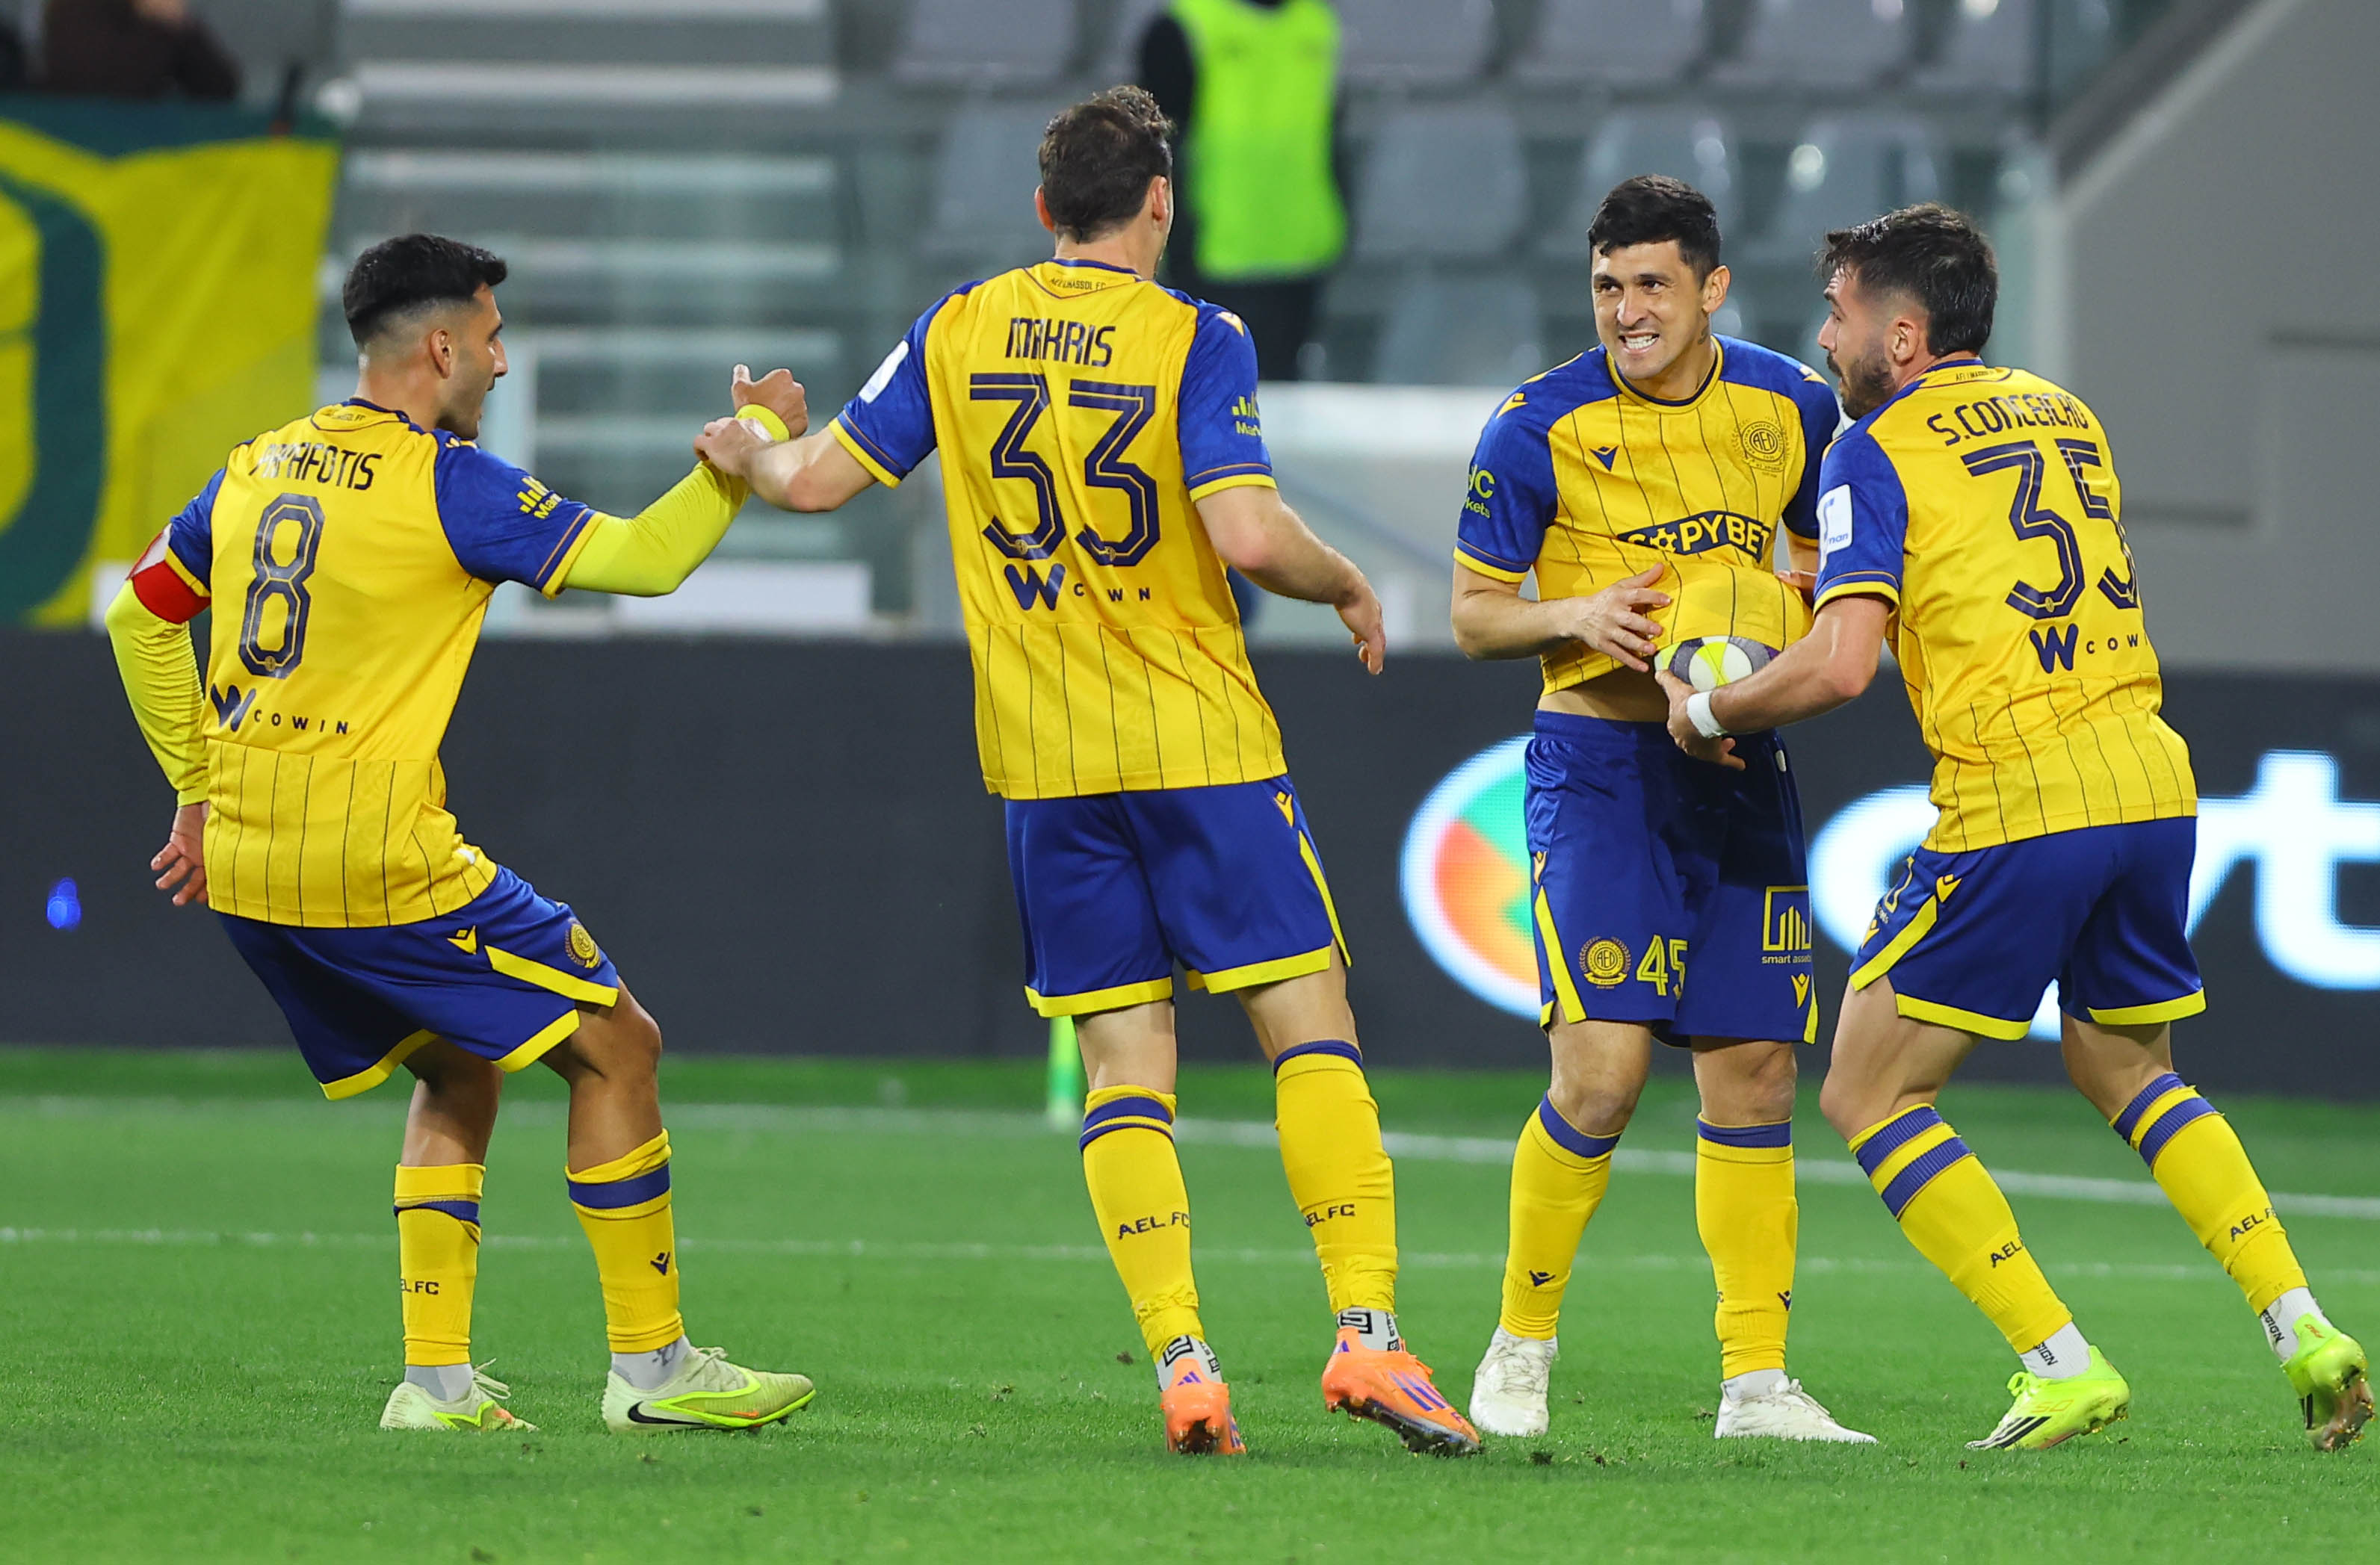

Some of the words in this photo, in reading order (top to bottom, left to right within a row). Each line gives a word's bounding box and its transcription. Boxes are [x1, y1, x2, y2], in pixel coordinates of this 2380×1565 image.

[1005, 317, 1116, 367] MAKRIS
[969, 374, 1160, 566] 33
[1962, 438, 2139, 619] 35
[238, 493, 325, 679] 8
[254, 710, 348, 734] COWIN
[1636, 935, 1687, 1000] 45
[1762, 955, 1791, 964] smart
[1328, 1204, 1355, 1219] FC
[1119, 1216, 1166, 1240] AEL
[1171, 1212, 1190, 1228] FC
[2231, 1214, 2264, 1243] AEL
[1991, 1241, 2021, 1268] AEL
[415, 1281, 439, 1295] FC
